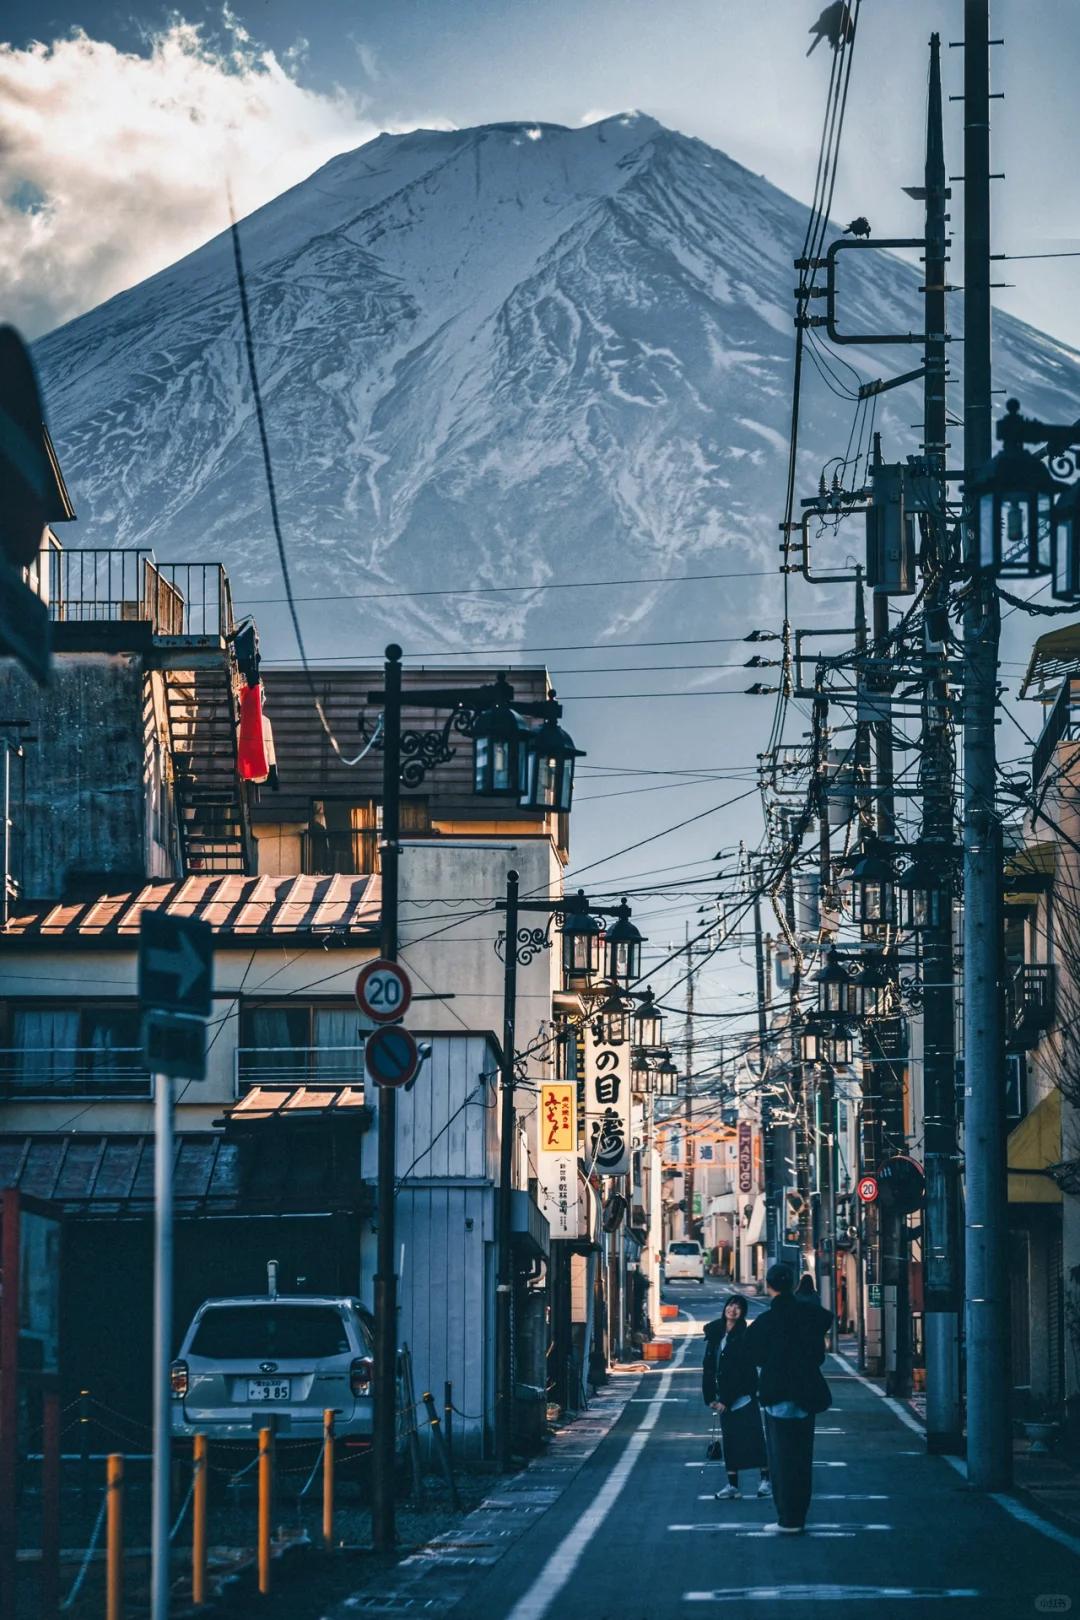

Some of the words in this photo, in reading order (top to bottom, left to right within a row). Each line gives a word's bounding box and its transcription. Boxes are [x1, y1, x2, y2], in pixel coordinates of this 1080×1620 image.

[368, 977, 400, 1005] 20
[740, 1137, 751, 1190] MARUGO
[863, 1184, 874, 1195] 20
